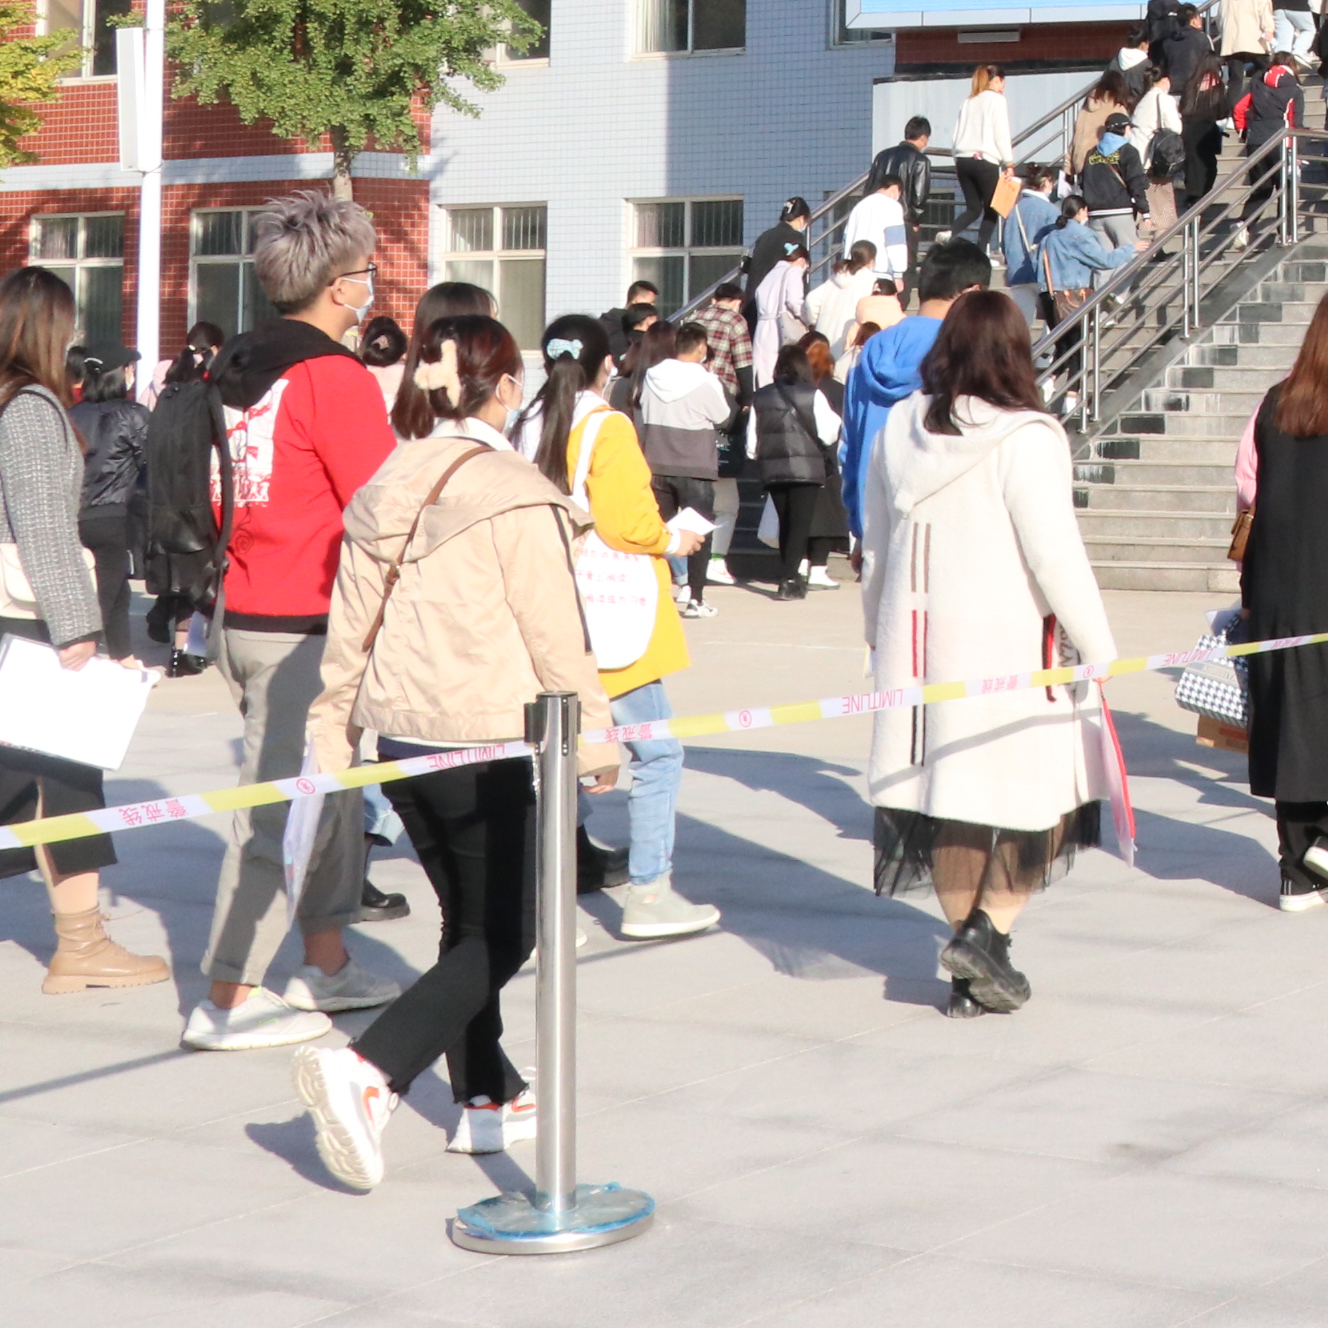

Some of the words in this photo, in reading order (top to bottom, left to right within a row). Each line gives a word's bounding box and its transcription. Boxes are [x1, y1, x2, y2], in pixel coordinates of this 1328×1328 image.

[842, 688, 904, 714] LIMITLINE
[118, 798, 189, 826] 警戒线
